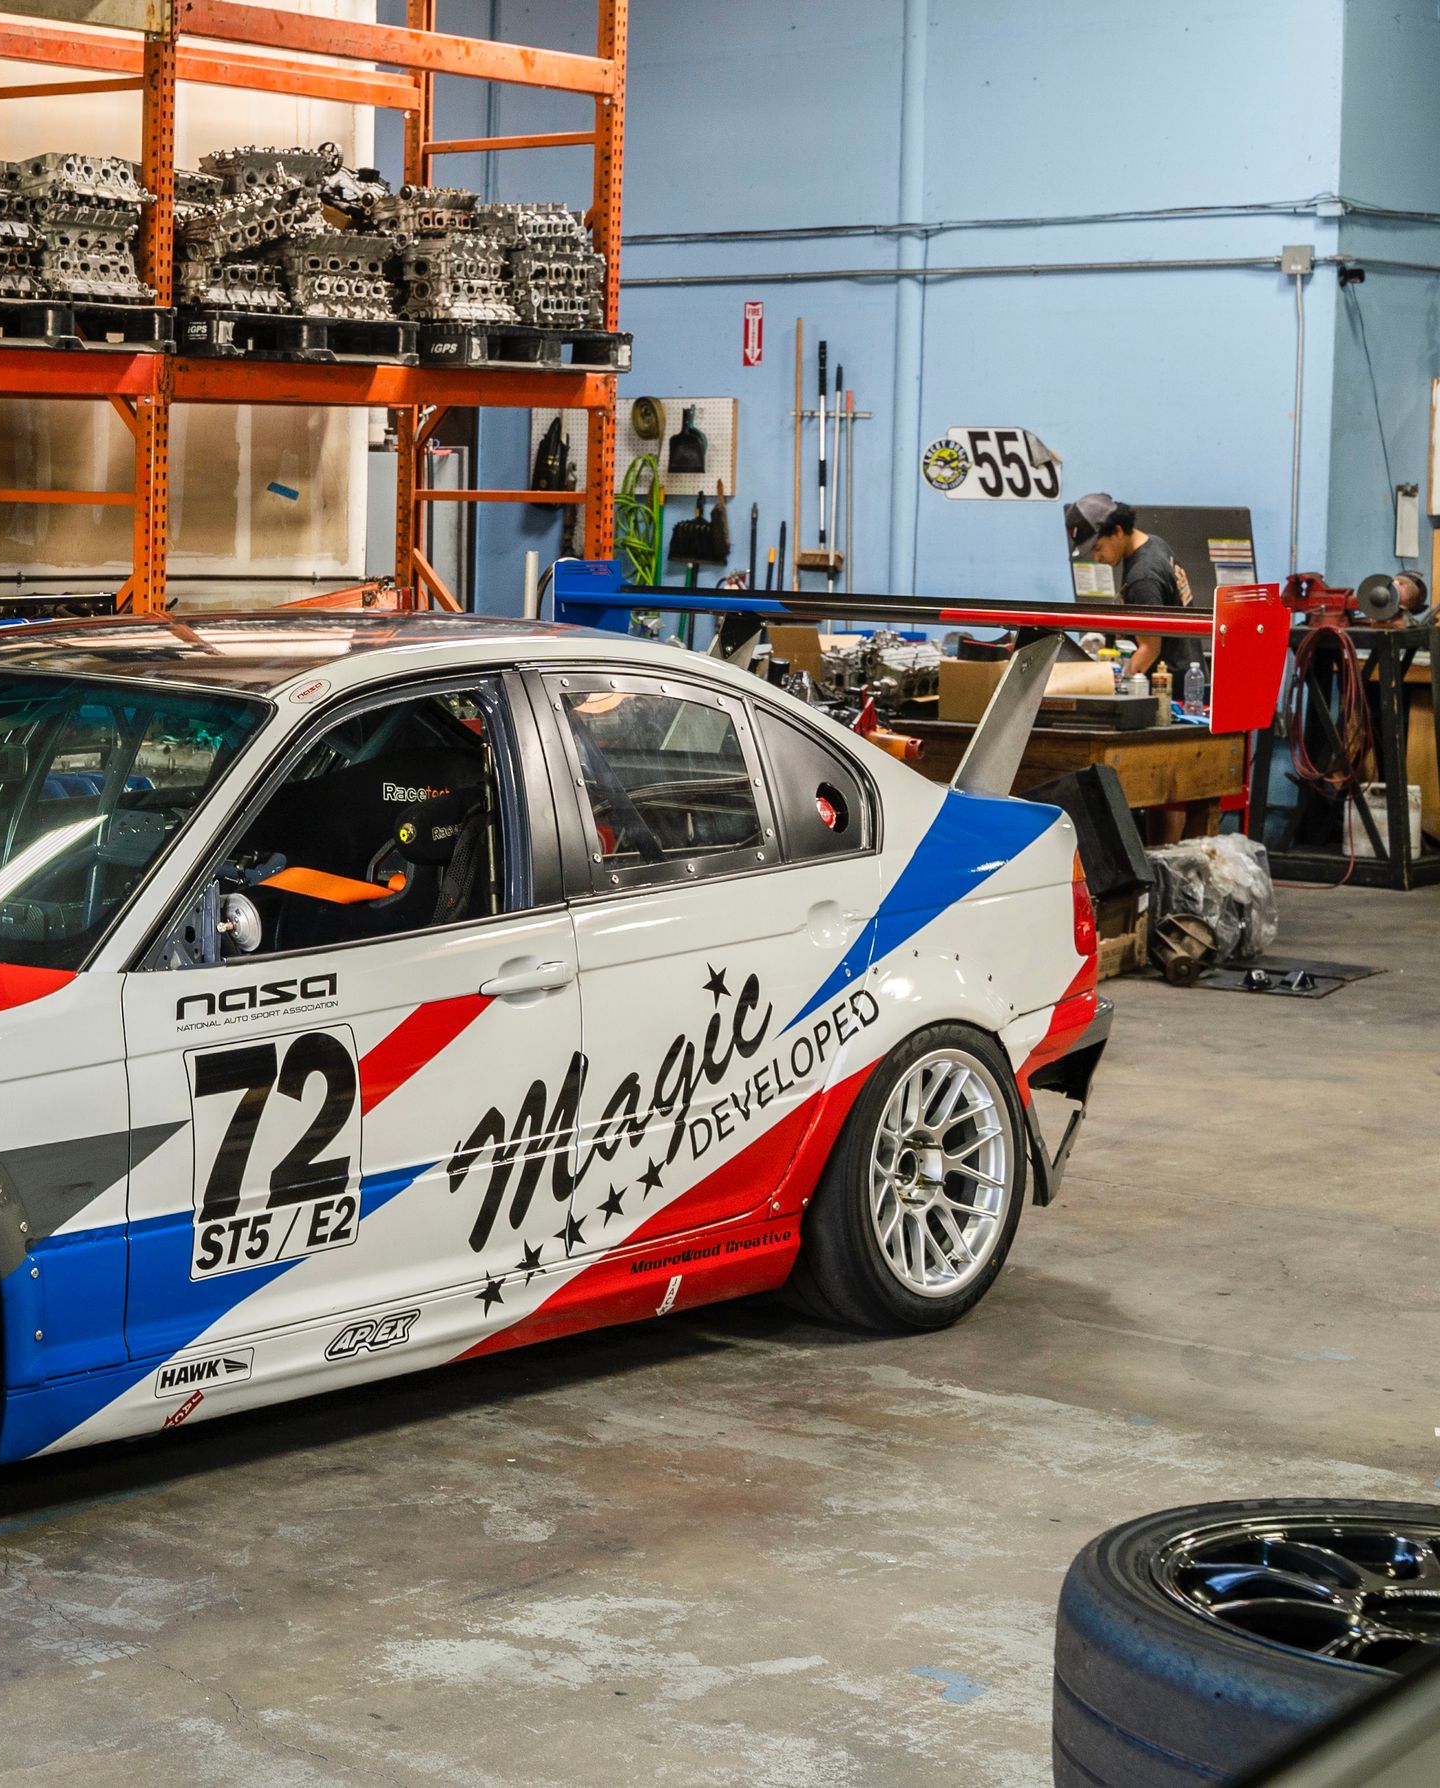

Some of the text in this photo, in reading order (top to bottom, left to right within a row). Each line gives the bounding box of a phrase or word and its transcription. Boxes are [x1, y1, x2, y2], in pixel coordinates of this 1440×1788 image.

[430, 343, 458, 354] iGPS
[967, 431, 1060, 498] 555
[175, 972, 338, 1021] nasa
[176, 1000, 339, 1033] NATIONAL AUTO SPORT ASSOCIATION
[688, 988, 881, 1162] DEVELOPED
[195, 1032, 357, 1224] 72
[446, 968, 774, 1253] Magic
[195, 1213, 274, 1271] ST5
[306, 1196, 356, 1248] E2
[630, 1231, 792, 1274] MooreWood Creative
[328, 1312, 417, 1356] APEX
[160, 1358, 224, 1390] HAWK
